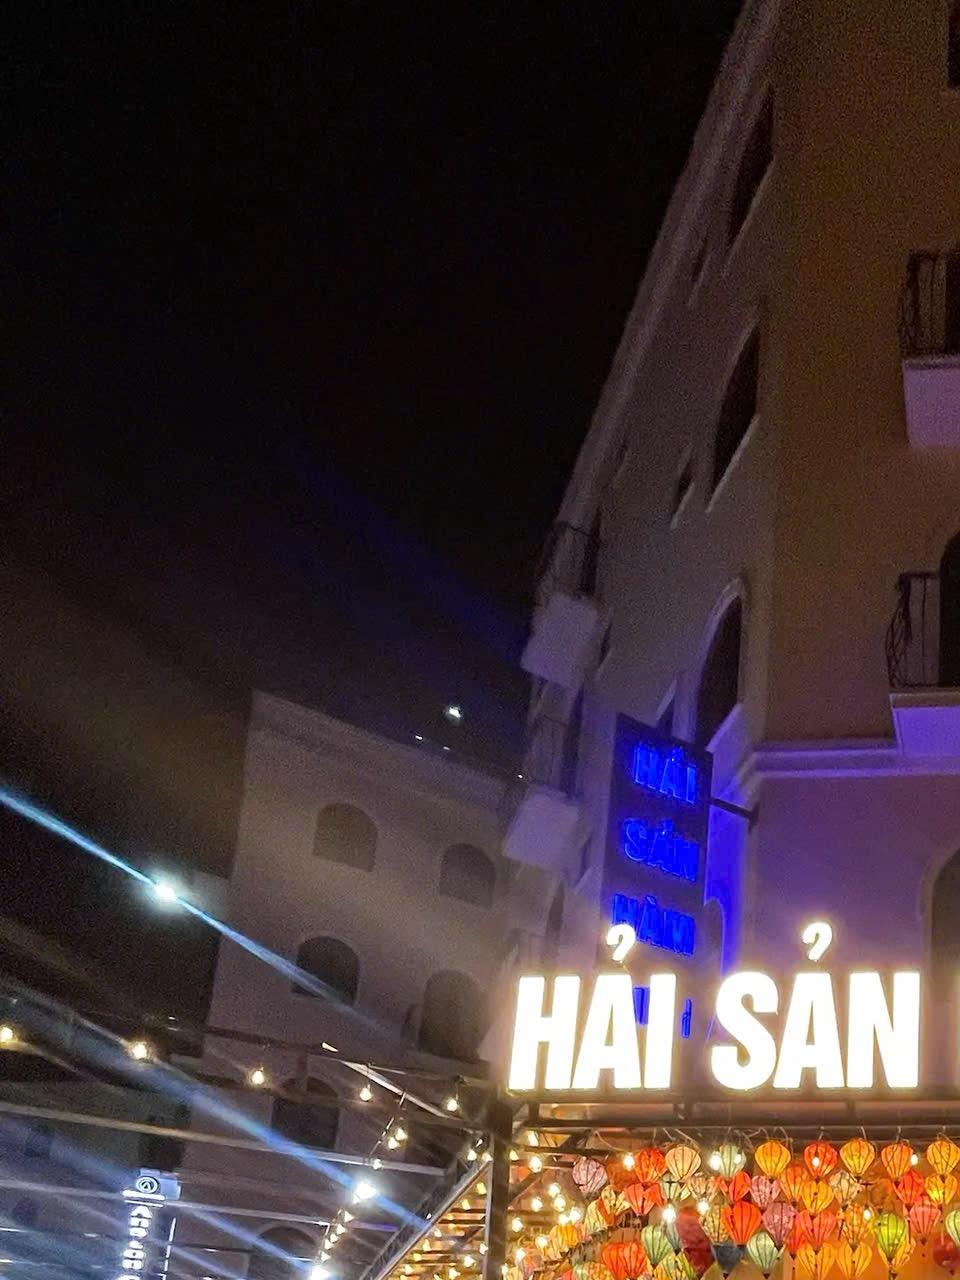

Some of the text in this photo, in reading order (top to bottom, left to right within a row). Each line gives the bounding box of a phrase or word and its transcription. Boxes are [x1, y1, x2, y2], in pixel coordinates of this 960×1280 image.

[633, 743, 698, 806] HẢI
[622, 817, 699, 882] SẢN
[509, 923, 676, 1089] HẢI
[711, 923, 920, 1089] SẢN
